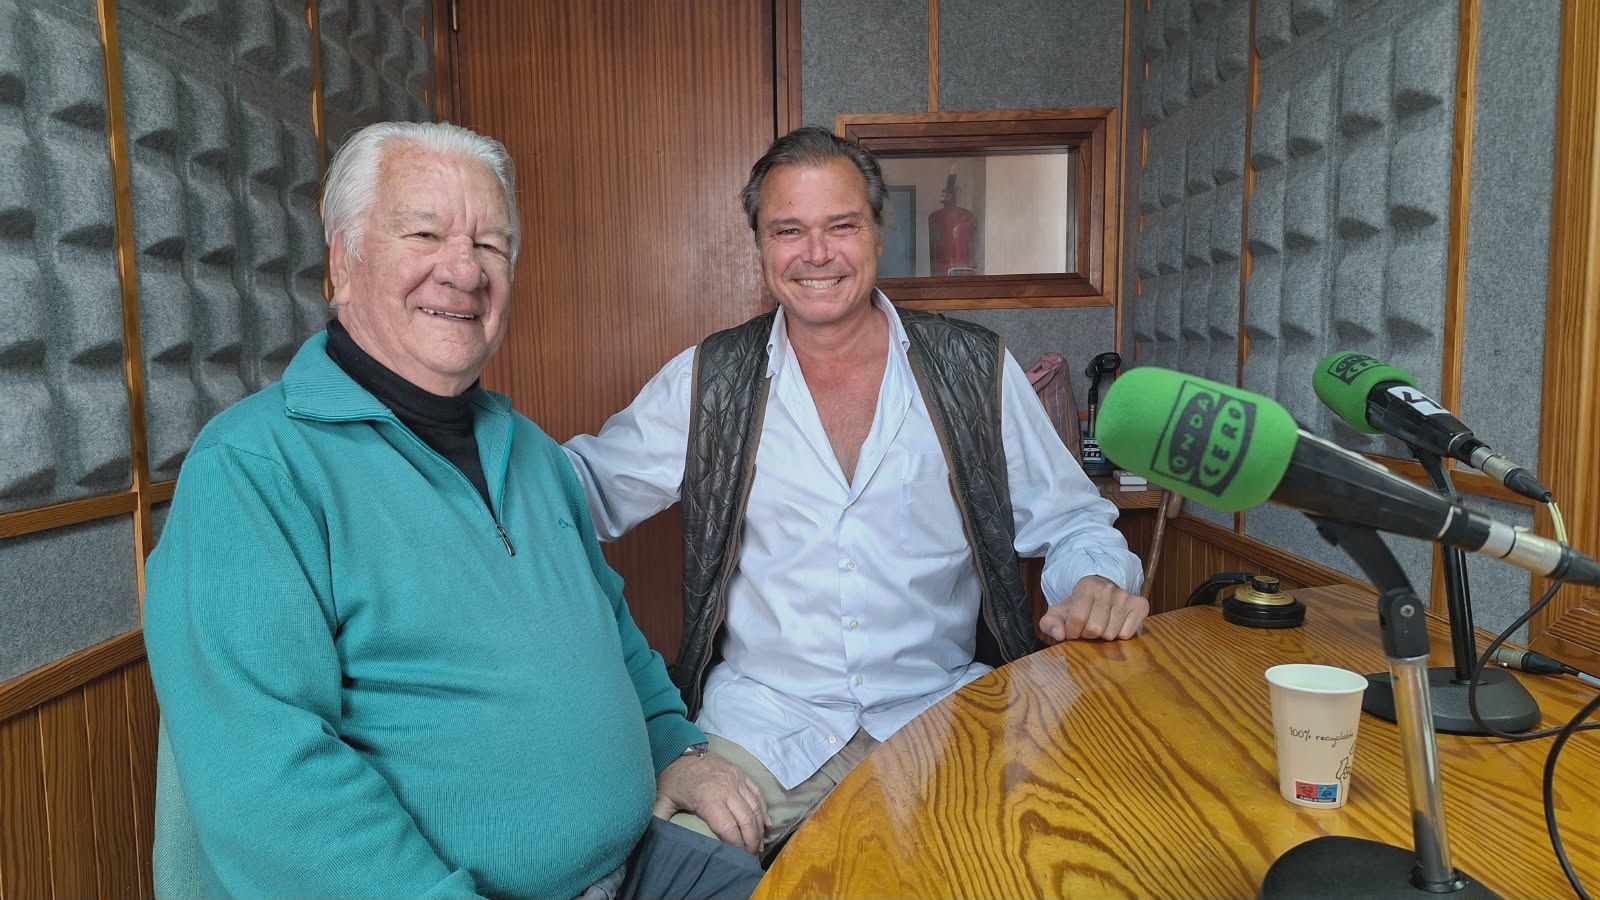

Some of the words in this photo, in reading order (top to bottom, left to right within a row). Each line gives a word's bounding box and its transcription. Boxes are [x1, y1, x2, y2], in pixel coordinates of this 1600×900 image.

[1172, 398, 1210, 468] ONDA
[1203, 407, 1242, 477] CERO
[1289, 726, 1311, 741] 100%
